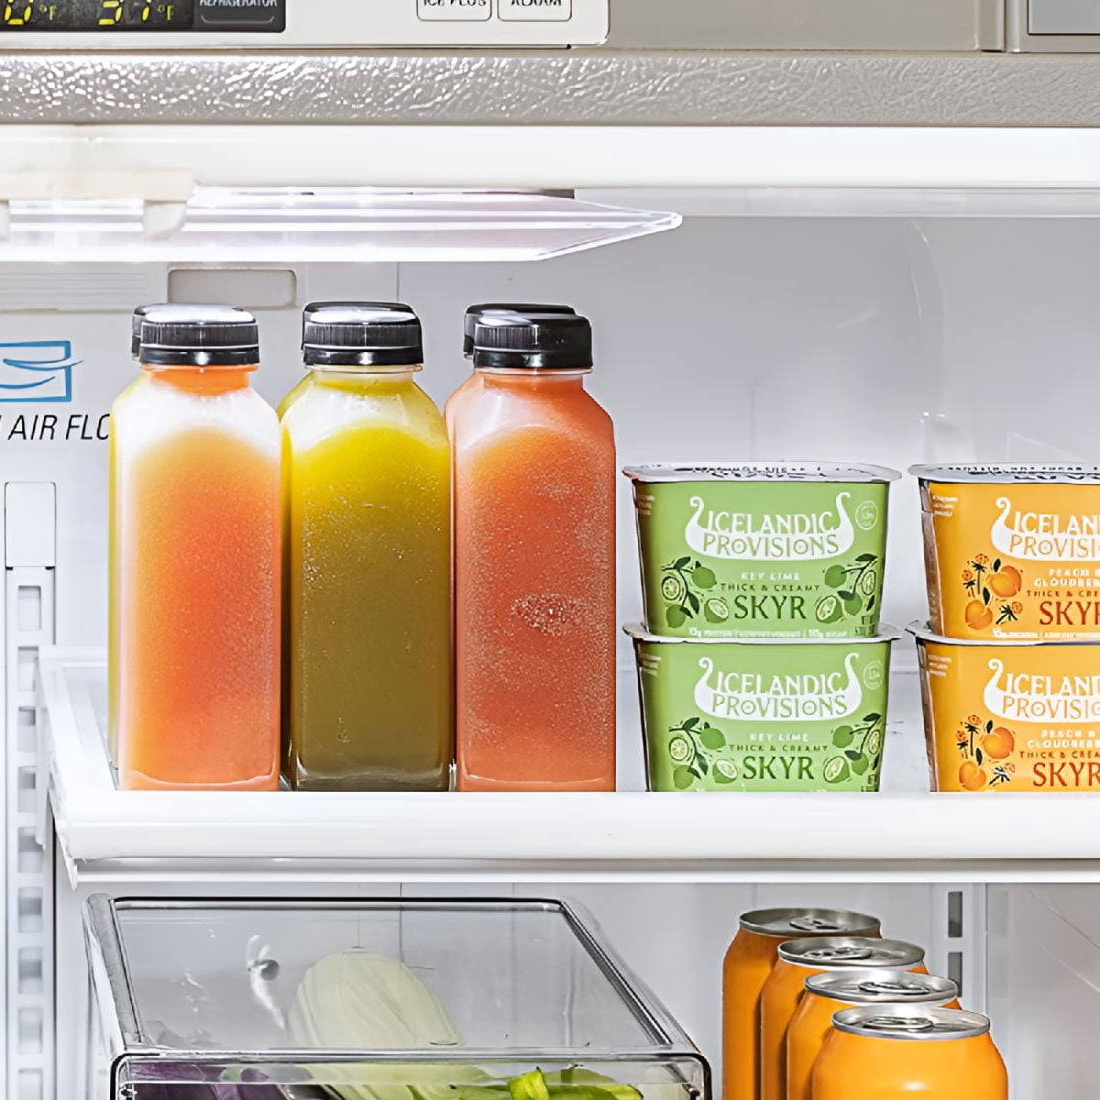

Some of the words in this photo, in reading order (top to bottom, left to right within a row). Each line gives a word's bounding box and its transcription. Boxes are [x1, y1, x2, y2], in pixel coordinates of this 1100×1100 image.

[7, 414, 58, 440] AIR
[65, 414, 110, 440] FLO
[706, 510, 836, 535] ICELANDIC
[1014, 511, 1100, 535] ICELAN
[703, 533, 840, 558] PROVISIONS
[1009, 534, 1100, 558] PROVISI
[734, 594, 808, 621] SKYR
[716, 671, 845, 696] ICELANDIC
[712, 693, 849, 718] PROVISIONS
[742, 756, 815, 780] SKYR
